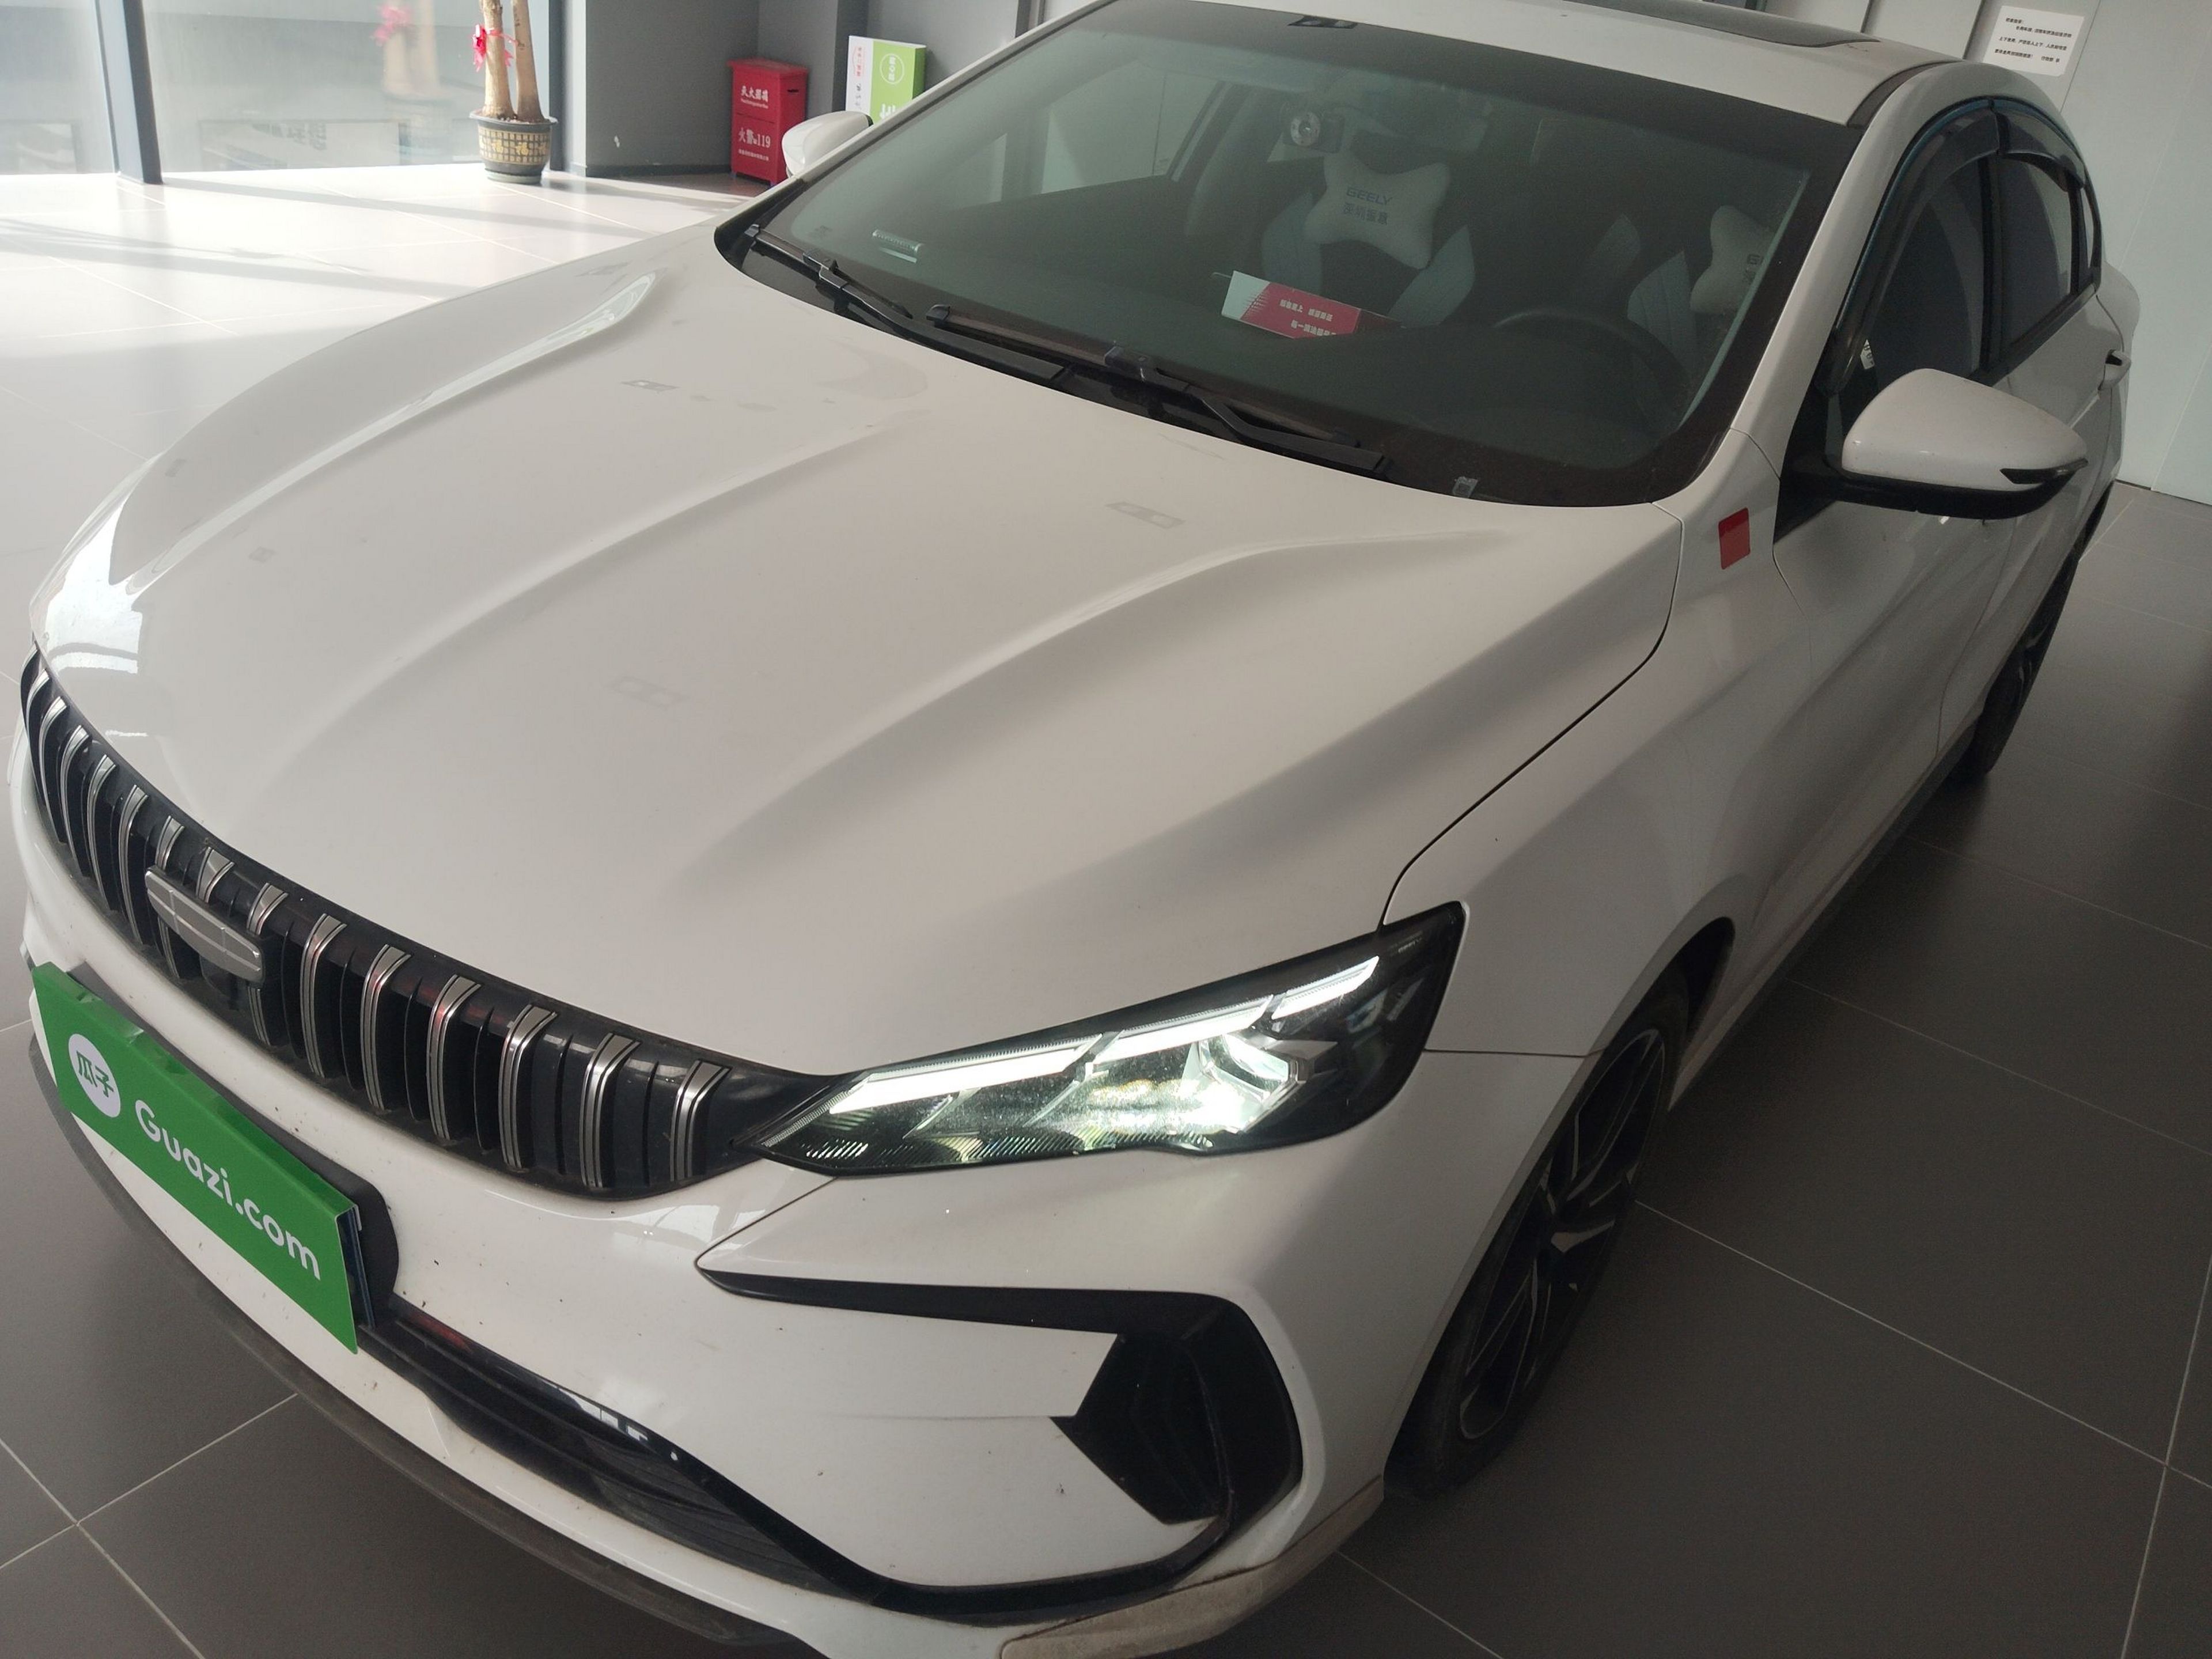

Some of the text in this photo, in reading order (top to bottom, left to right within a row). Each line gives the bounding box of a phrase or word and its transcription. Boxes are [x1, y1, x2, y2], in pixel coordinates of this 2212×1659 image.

[1346, 187, 1393, 204] GEELY
[76, 1050, 114, 1098] 瓜子
[135, 1099, 321, 1281] Guazi.com
